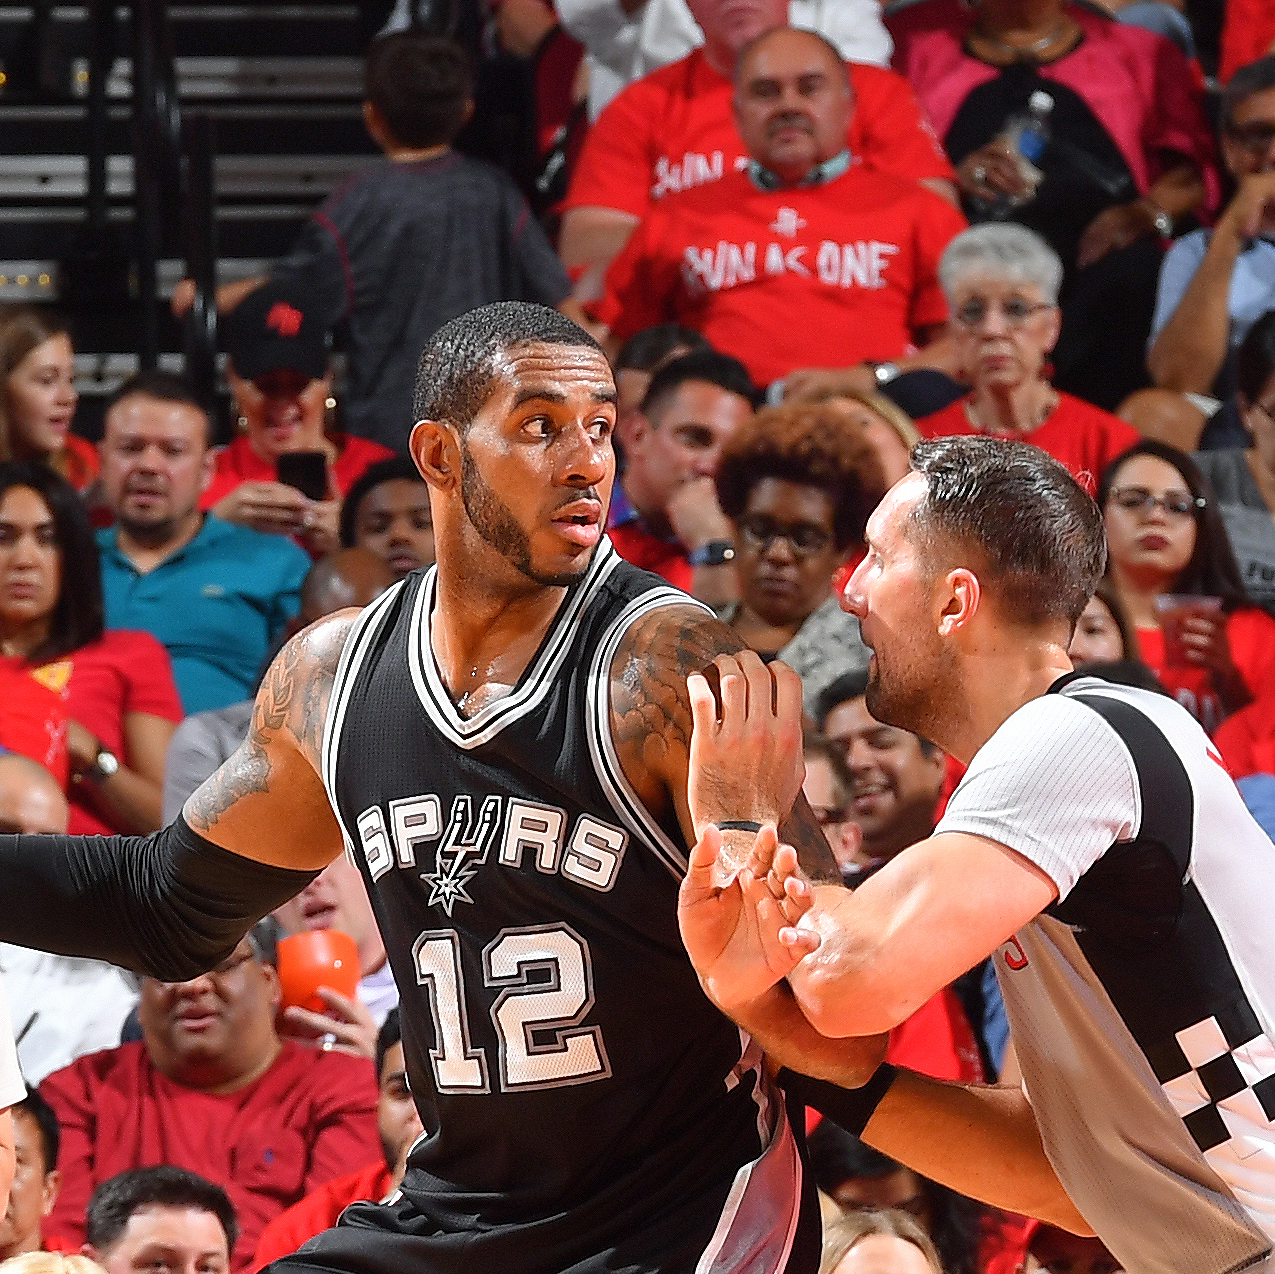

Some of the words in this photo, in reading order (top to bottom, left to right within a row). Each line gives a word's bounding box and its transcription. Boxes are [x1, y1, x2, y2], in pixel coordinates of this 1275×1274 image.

[683, 240, 757, 296] RUN
[817, 240, 900, 289] ONE
[356, 793, 628, 900] SPURS
[412, 921, 612, 1095] 12
